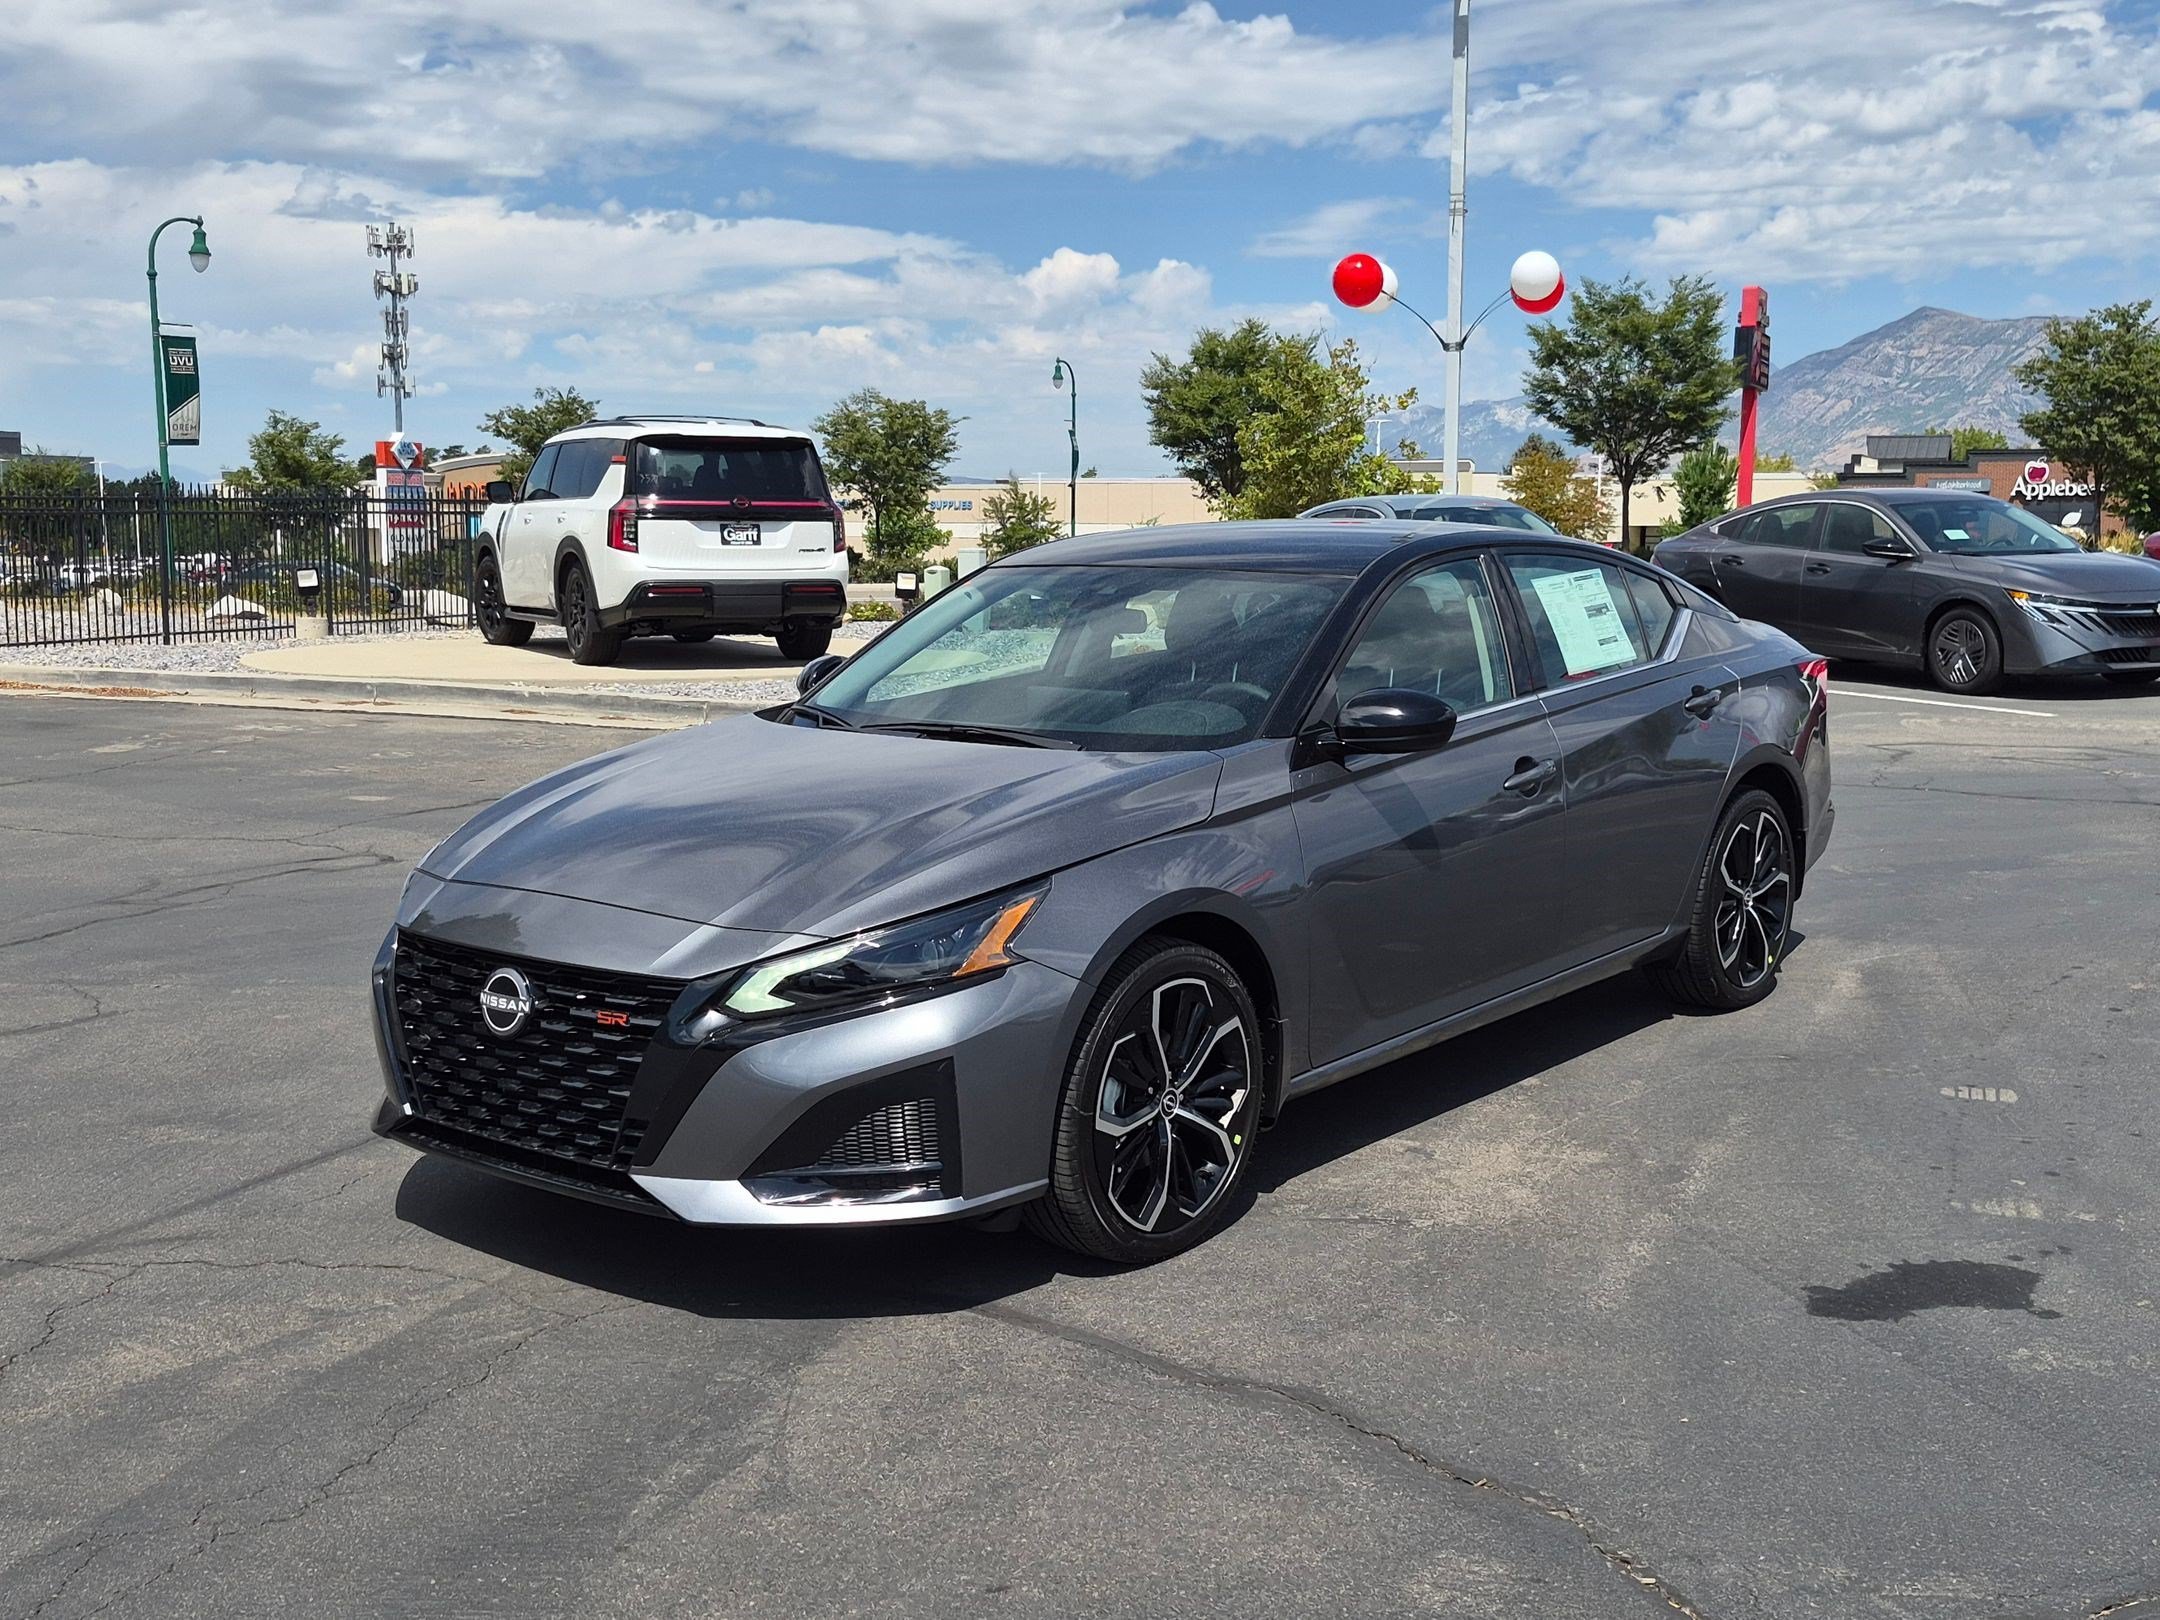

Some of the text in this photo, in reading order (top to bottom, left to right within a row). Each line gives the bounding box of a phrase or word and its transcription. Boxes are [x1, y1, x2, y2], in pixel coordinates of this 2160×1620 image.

[169, 356, 194, 366] UVU
[172, 423, 197, 433] OREM
[930, 500, 974, 512] SUPPLIES
[723, 527, 759, 542] Garff
[479, 991, 531, 1013] NISSAN
[597, 1010, 631, 1027] SR
